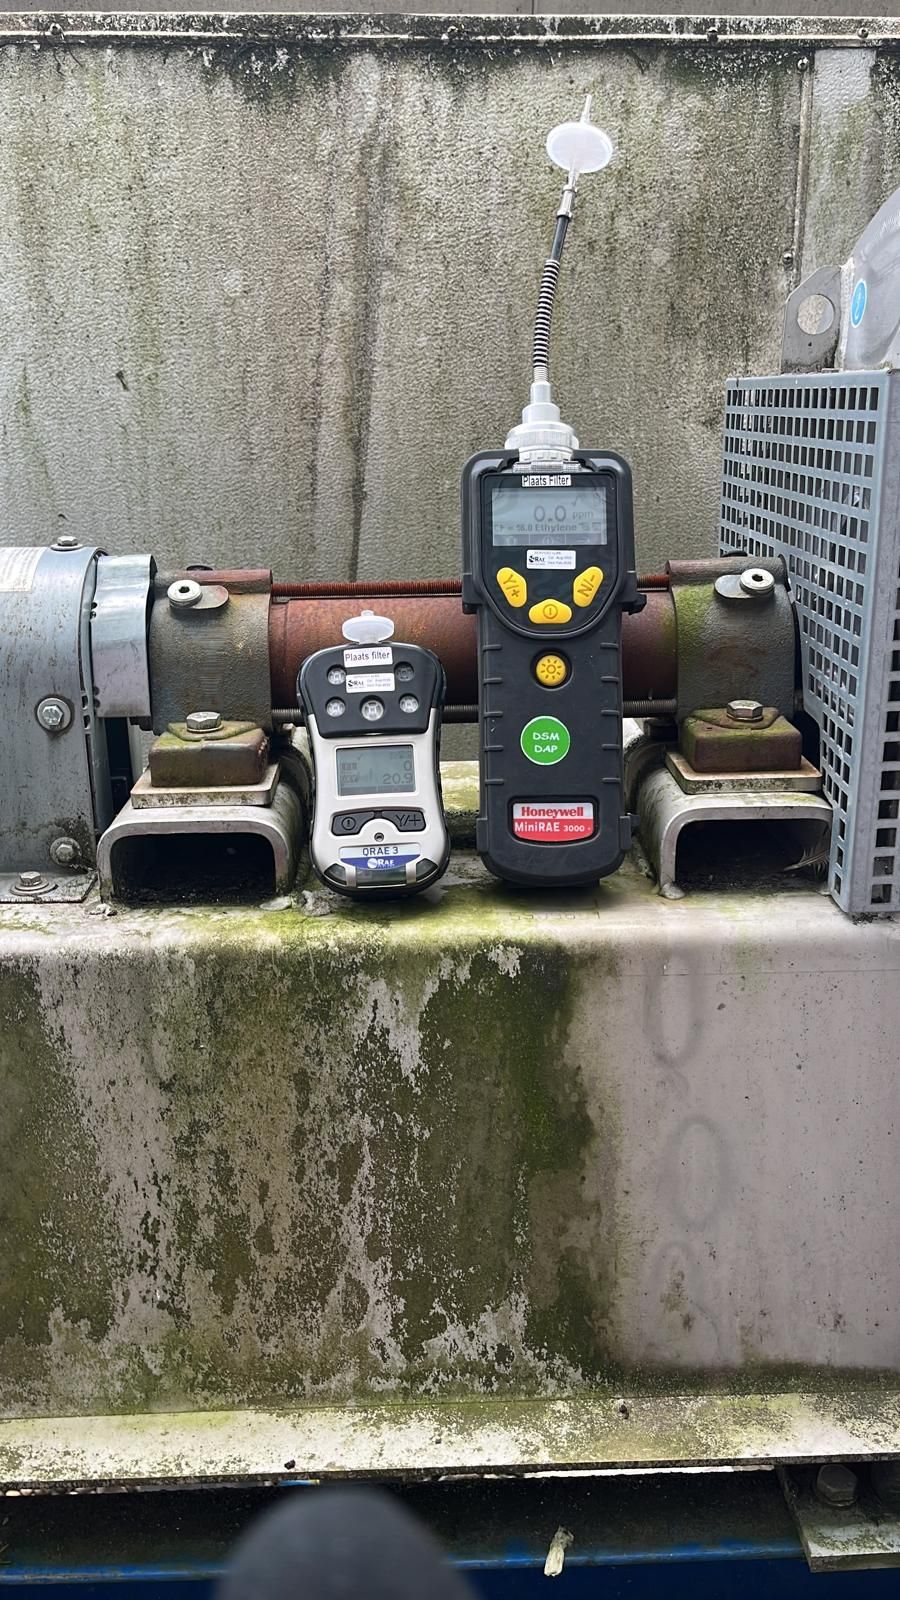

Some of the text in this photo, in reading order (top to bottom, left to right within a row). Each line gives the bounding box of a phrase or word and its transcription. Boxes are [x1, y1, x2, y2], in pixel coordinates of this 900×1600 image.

[523, 475, 569, 486] Plaats Filter
[534, 505, 594, 522] 0.0 ppm
[535, 524, 577, 533] Ethylene
[345, 651, 390, 661] Plaats filter
[533, 732, 560, 741] DSM
[534, 745, 558, 753] DAP
[403, 760, 412, 771] 0
[382, 772, 413, 784] 20.9
[521, 806, 584, 818] Honeywell
[514, 822, 560, 832] MiniRAE
[362, 846, 399, 856] QRAE 3
[376, 858, 395, 866] RAE
